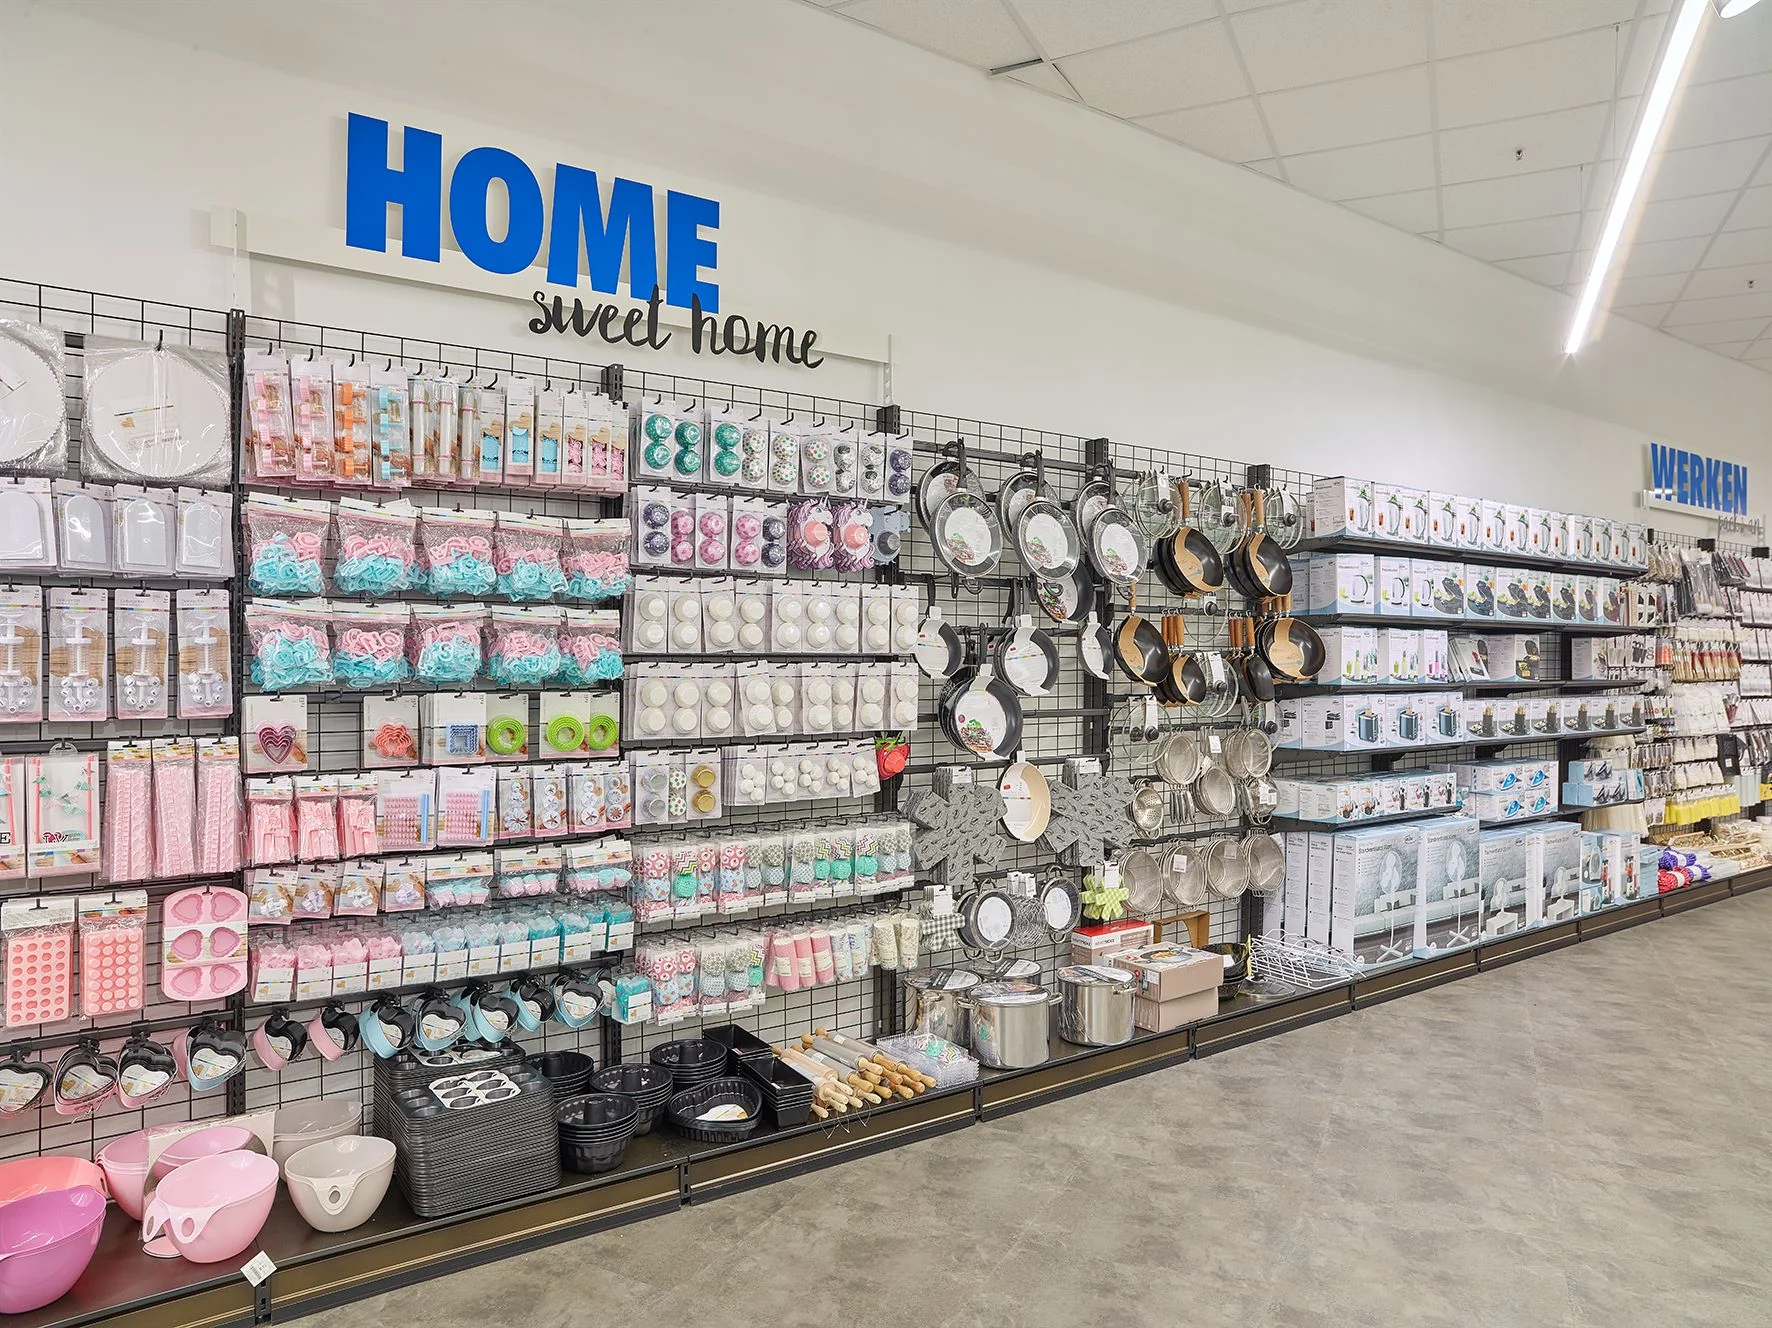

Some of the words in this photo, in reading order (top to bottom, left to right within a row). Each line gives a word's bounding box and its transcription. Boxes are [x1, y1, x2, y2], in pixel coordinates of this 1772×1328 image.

[346, 111, 719, 313] HOME
[528, 284, 672, 351] sweet
[691, 292, 824, 369] home
[1650, 442, 1748, 516] WERKEN
